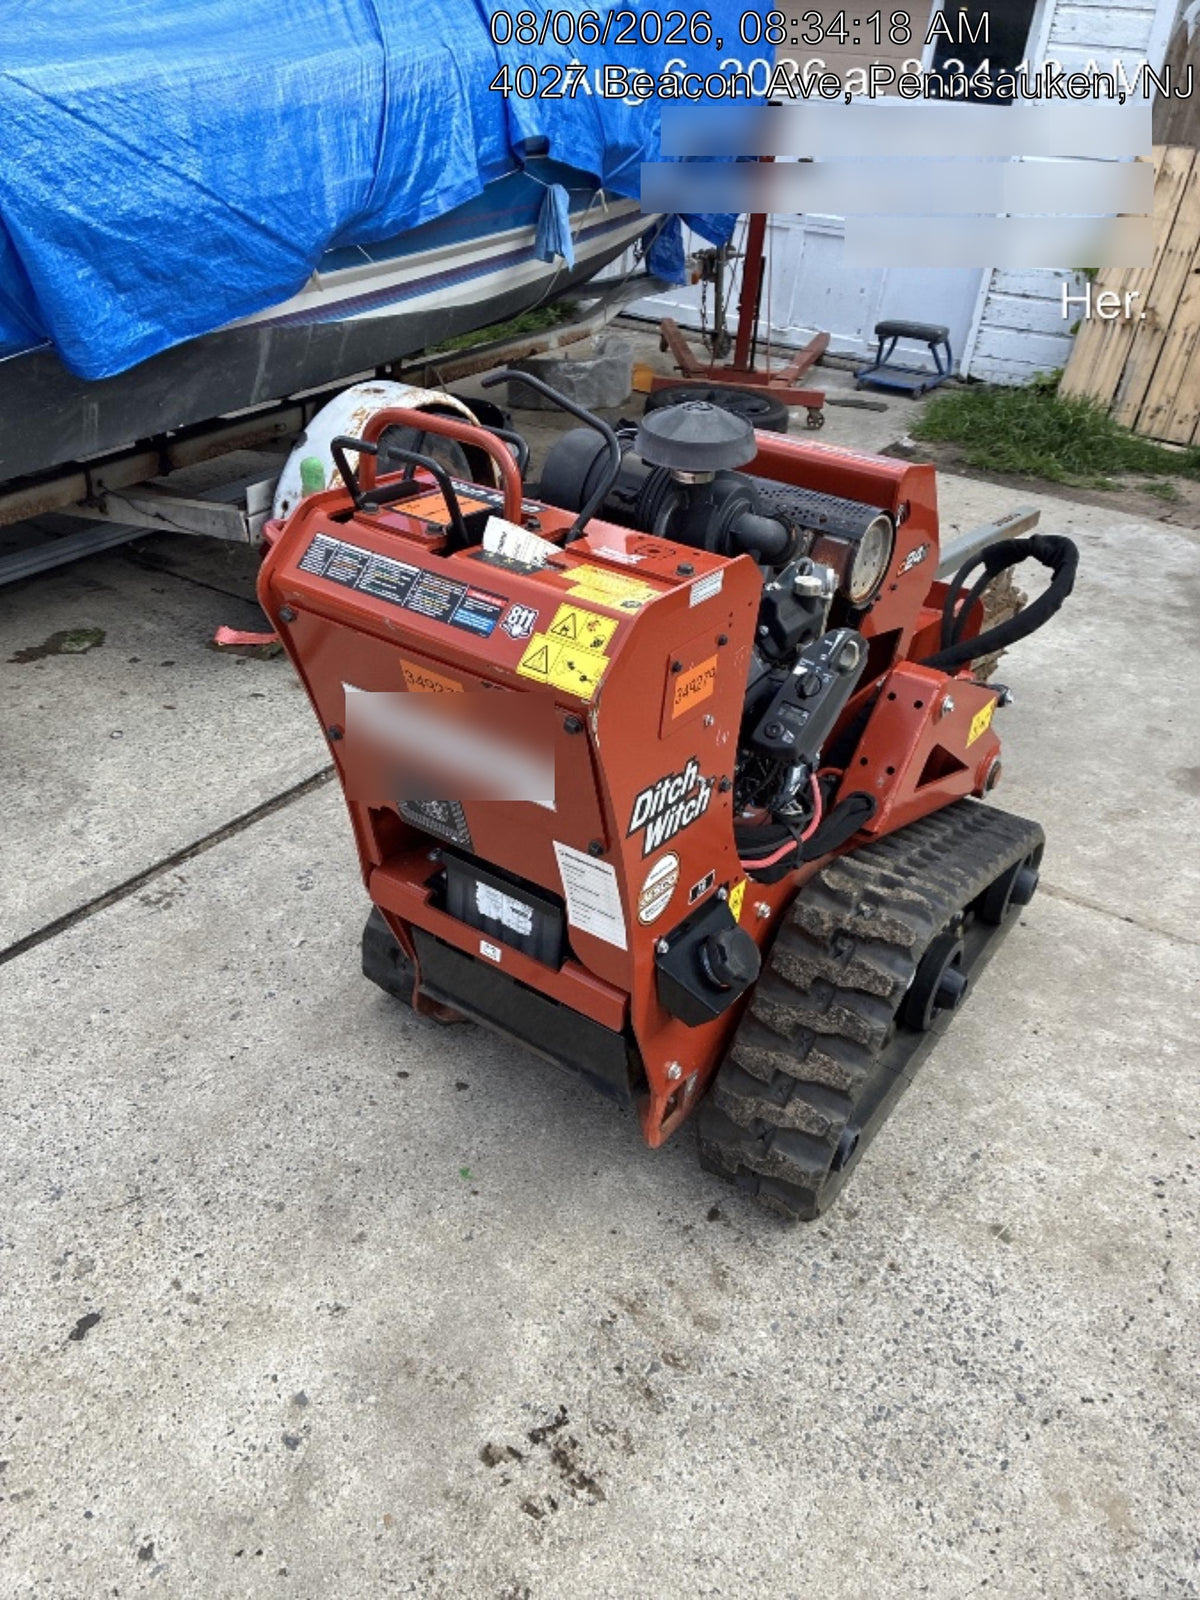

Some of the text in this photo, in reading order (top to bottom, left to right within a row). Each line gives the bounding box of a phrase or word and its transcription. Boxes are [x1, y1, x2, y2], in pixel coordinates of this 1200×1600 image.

[507, 604, 536, 631] 811
[627, 757, 700, 836] Ditch
[643, 777, 713, 857] Witch
